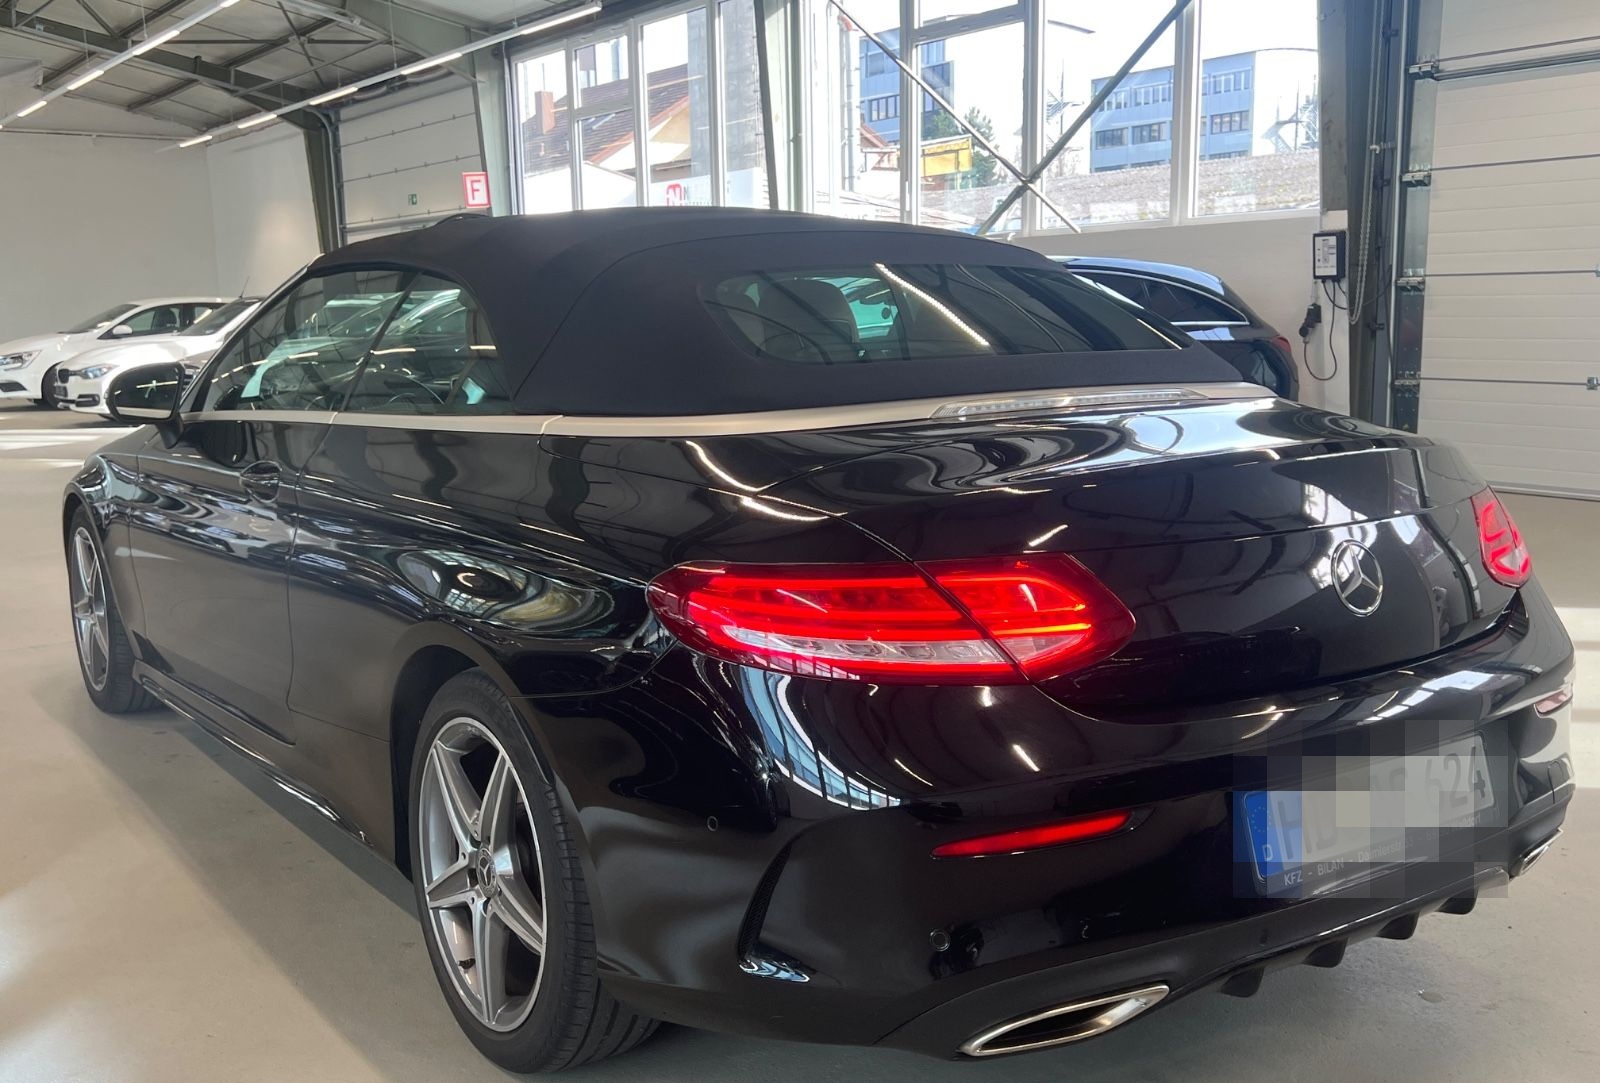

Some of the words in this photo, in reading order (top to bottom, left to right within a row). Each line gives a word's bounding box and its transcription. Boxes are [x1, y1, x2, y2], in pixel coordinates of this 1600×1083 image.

[471, 179, 482, 201] F
[1262, 844, 1274, 862] D
[1283, 870, 1304, 887] KFZ
[1317, 857, 1345, 876] BILAN
